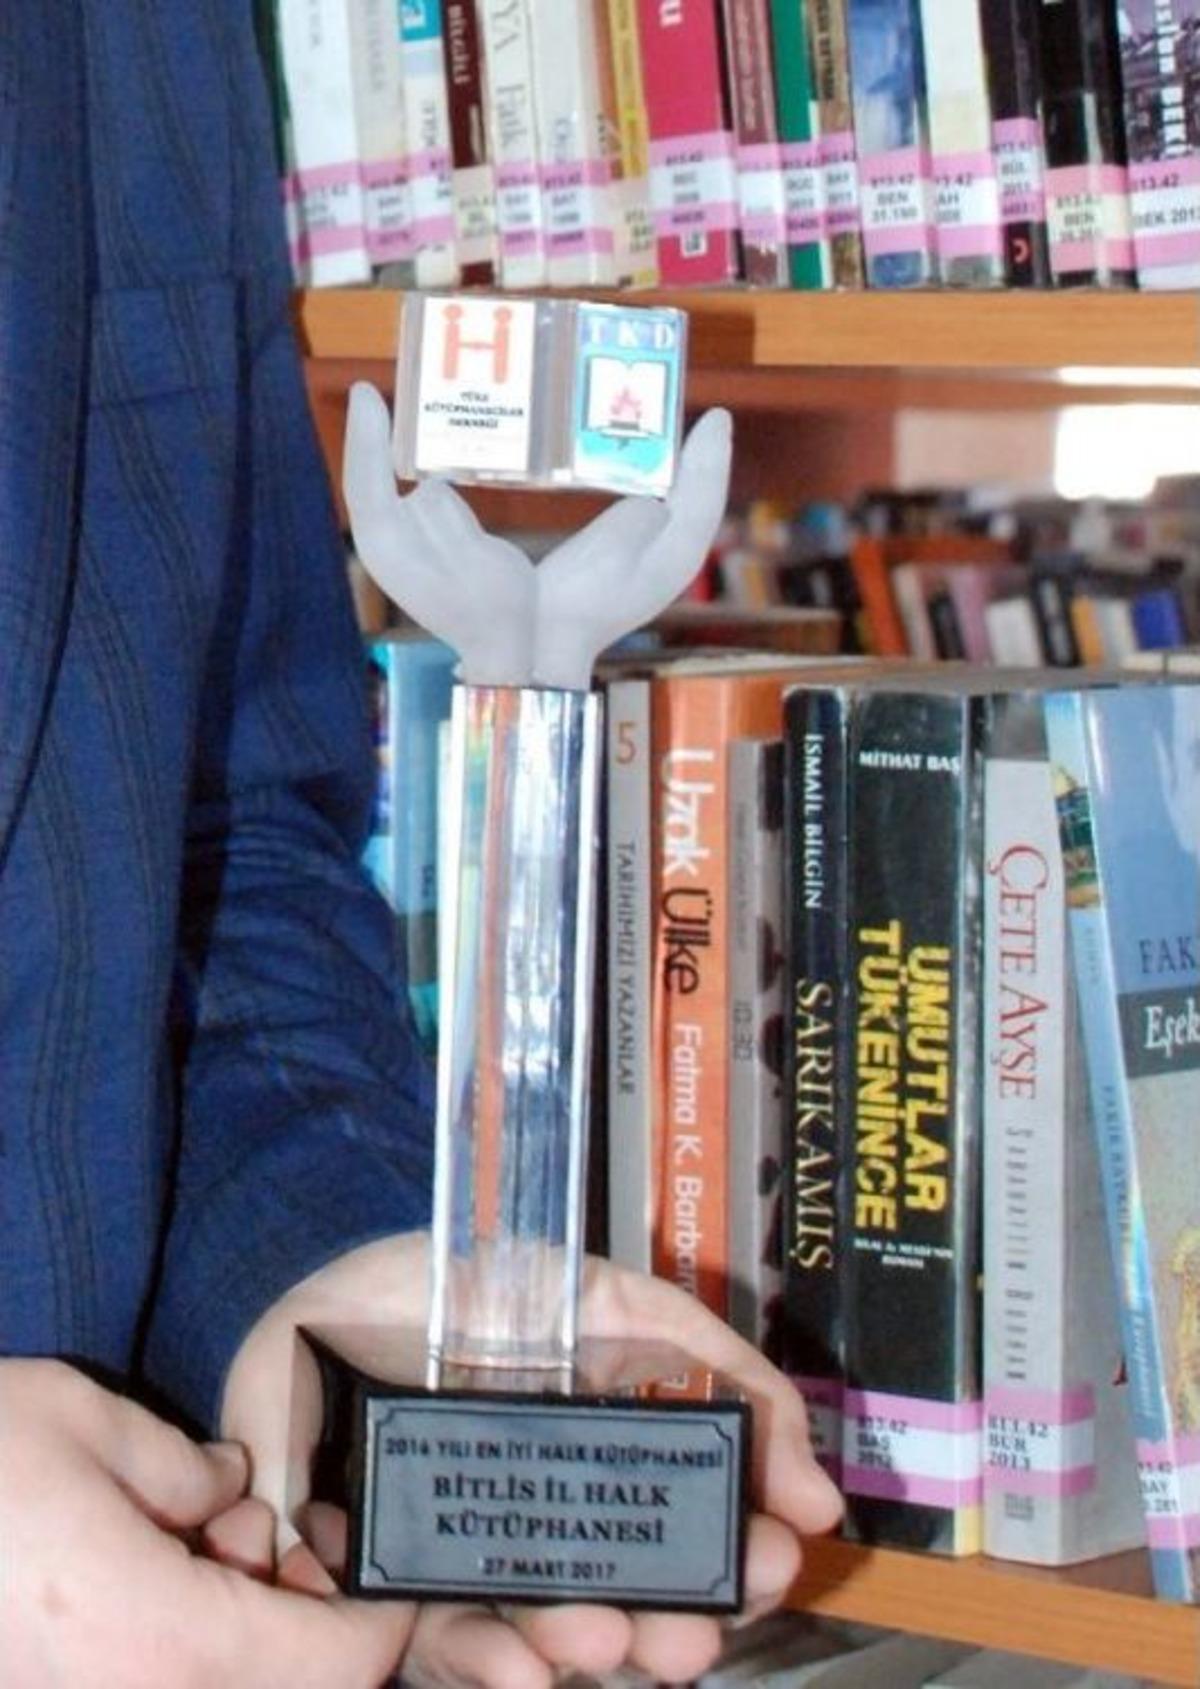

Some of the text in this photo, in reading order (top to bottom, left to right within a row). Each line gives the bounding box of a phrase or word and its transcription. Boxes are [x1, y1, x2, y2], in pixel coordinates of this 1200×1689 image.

[616, 722, 637, 766] 5
[859, 749, 922, 771] MİTHAT
[662, 749, 715, 995] Uzak Ülke
[988, 842, 1050, 1100] ÇETE AYŞE
[1139, 935, 1196, 974] FAK
[617, 975, 636, 1095] YAZANLAR
[671, 1023, 703, 1126] Fatma
[855, 918, 907, 1232] TÜKENİNCE
[904, 945, 952, 1212] UMUTLAR
[788, 977, 835, 1271] SARIKAMIŞ
[673, 1135, 703, 1166] K.
[476, 1441, 502, 1460] EN
[538, 1442, 586, 1462] HALK
[594, 1443, 724, 1468] KÜTÜPHANESİ
[433, 1471, 671, 1508] BİTLİS İL HALK
[435, 1508, 665, 1544] KÜTÜPHANESİ
[483, 1557, 617, 1580] 27 MART 2017
